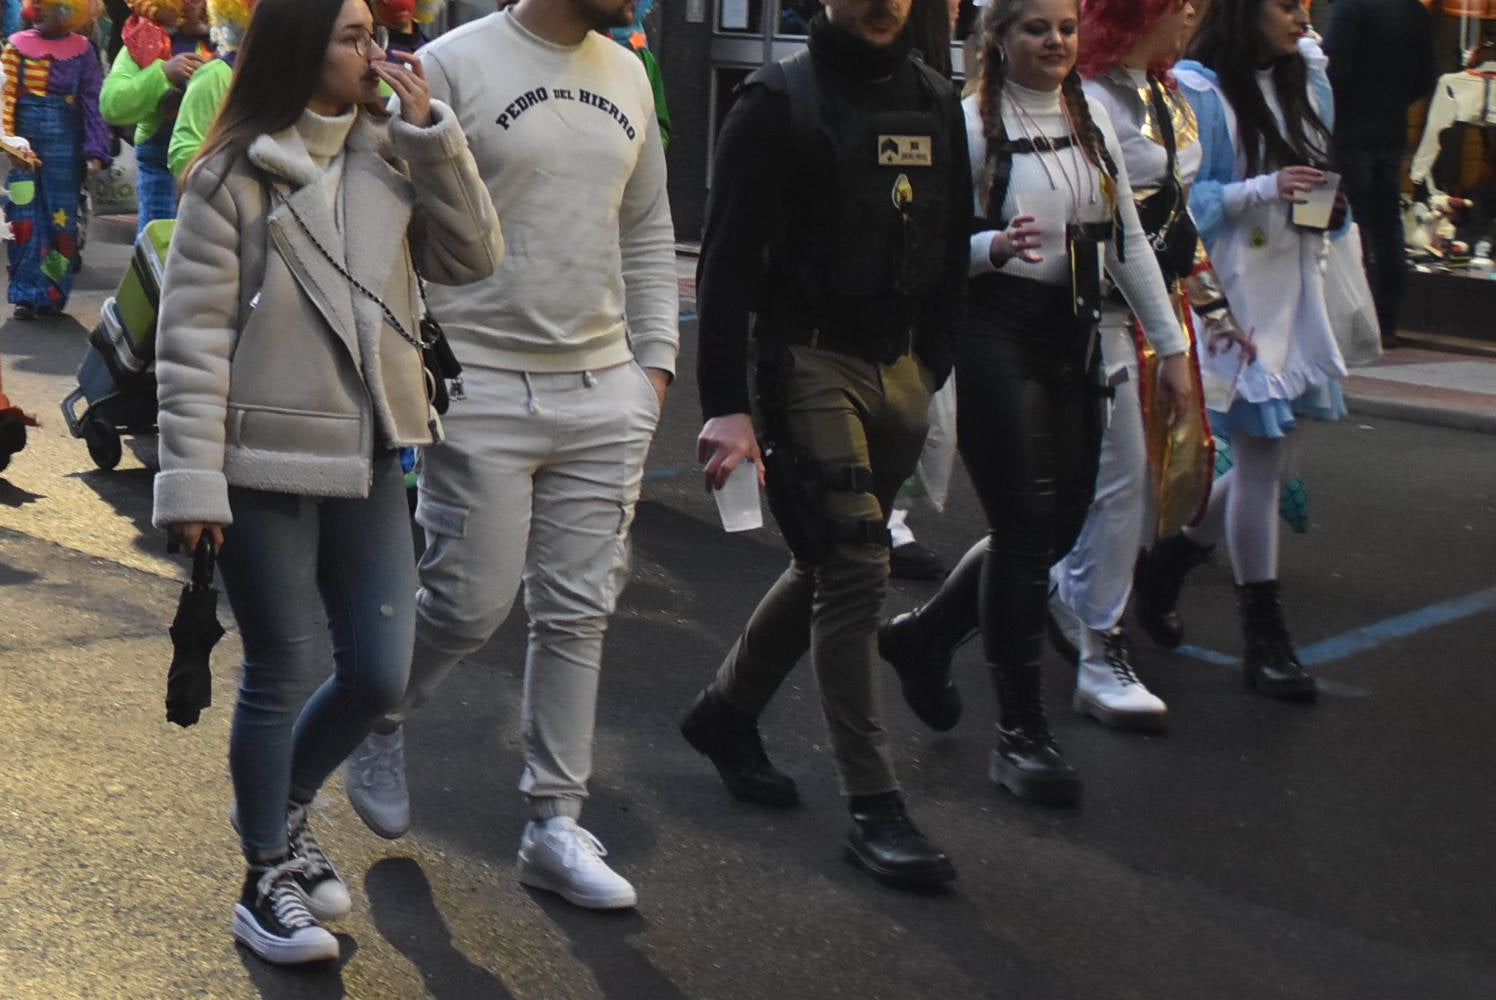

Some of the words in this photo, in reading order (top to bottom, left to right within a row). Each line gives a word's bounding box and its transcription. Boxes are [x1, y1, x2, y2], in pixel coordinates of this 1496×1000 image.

[496, 86, 549, 131] PEDRO
[553, 88, 575, 101] DEL
[579, 88, 636, 141] HIERRO
